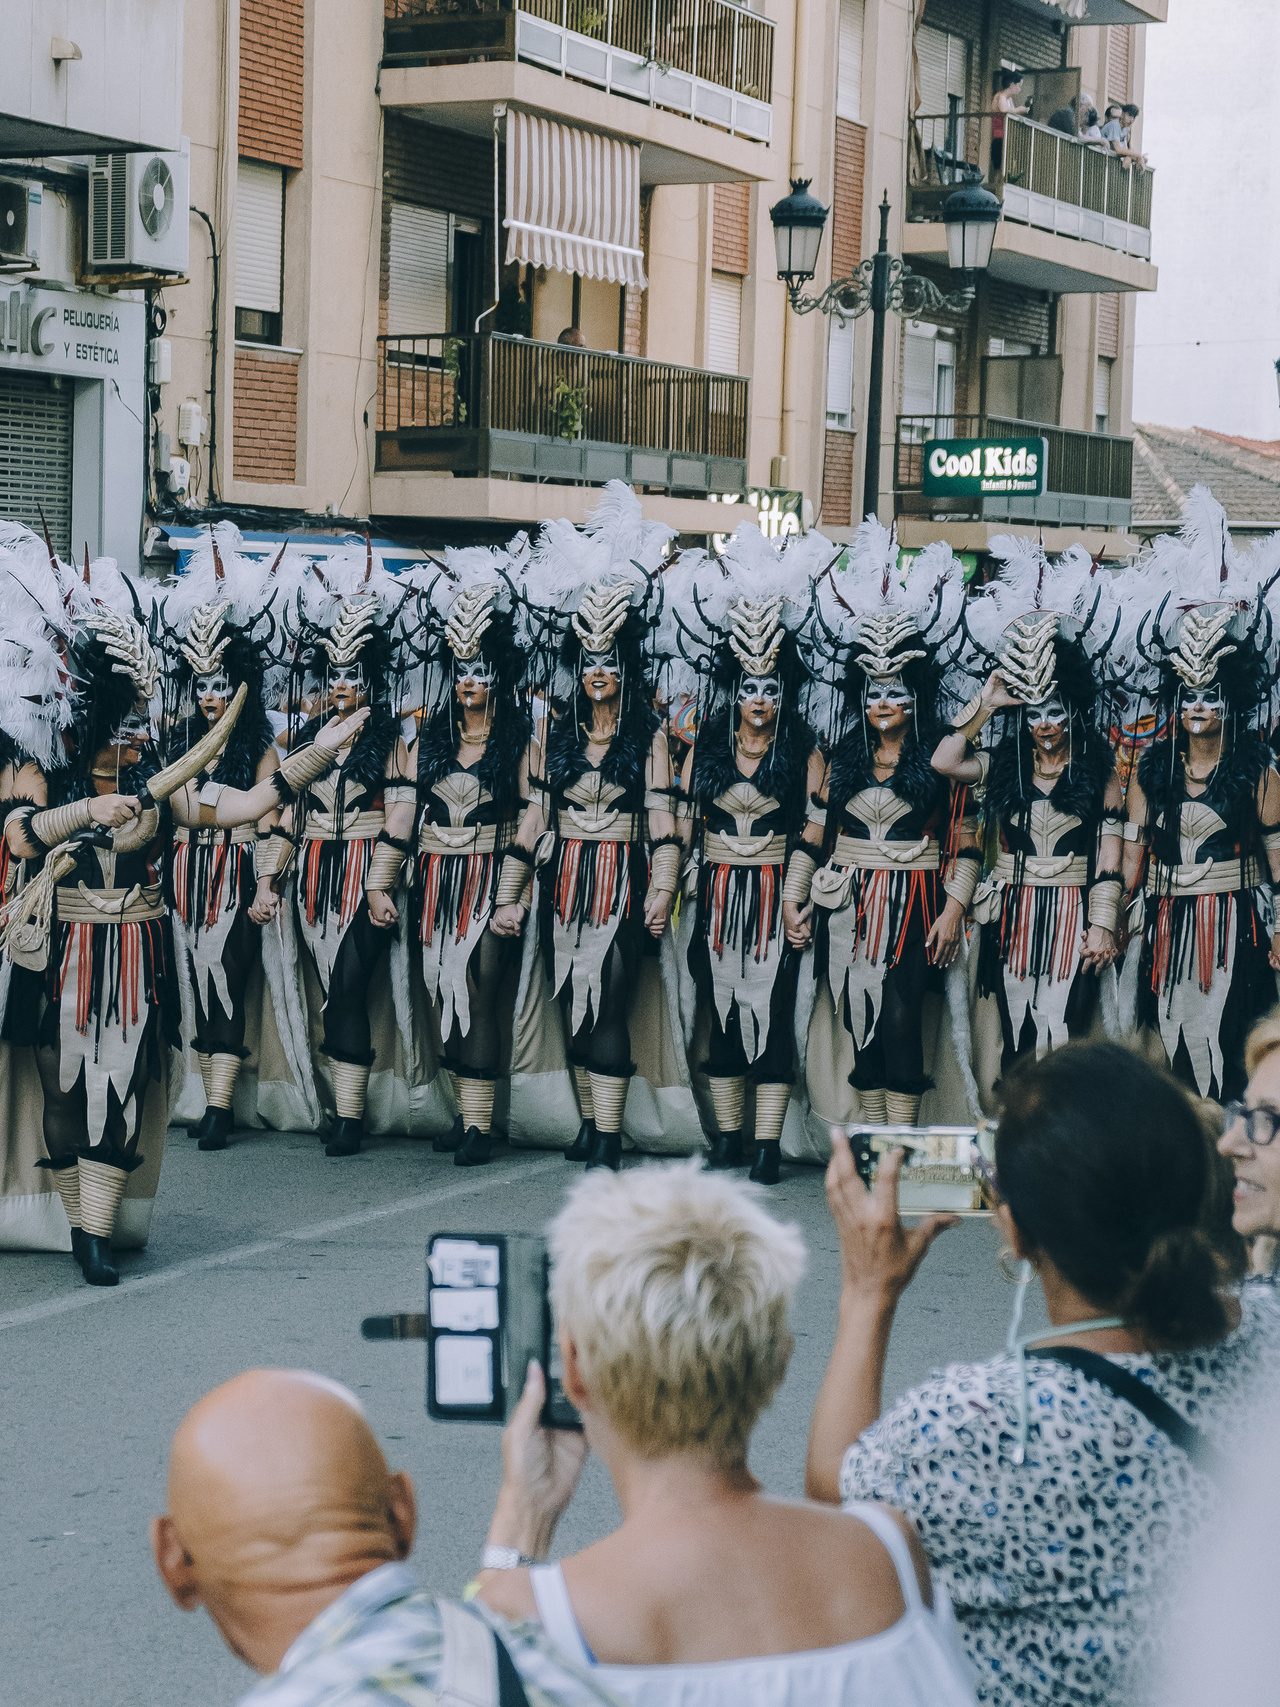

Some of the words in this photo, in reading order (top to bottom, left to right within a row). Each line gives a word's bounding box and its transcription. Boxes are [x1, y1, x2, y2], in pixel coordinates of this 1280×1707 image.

[63, 308, 120, 333] PELUQUERÍA
[63, 341, 70, 359] Y
[76, 341, 120, 365] ESTÉTICA
[928, 446, 982, 477] Cool
[984, 446, 1038, 477] Kids
